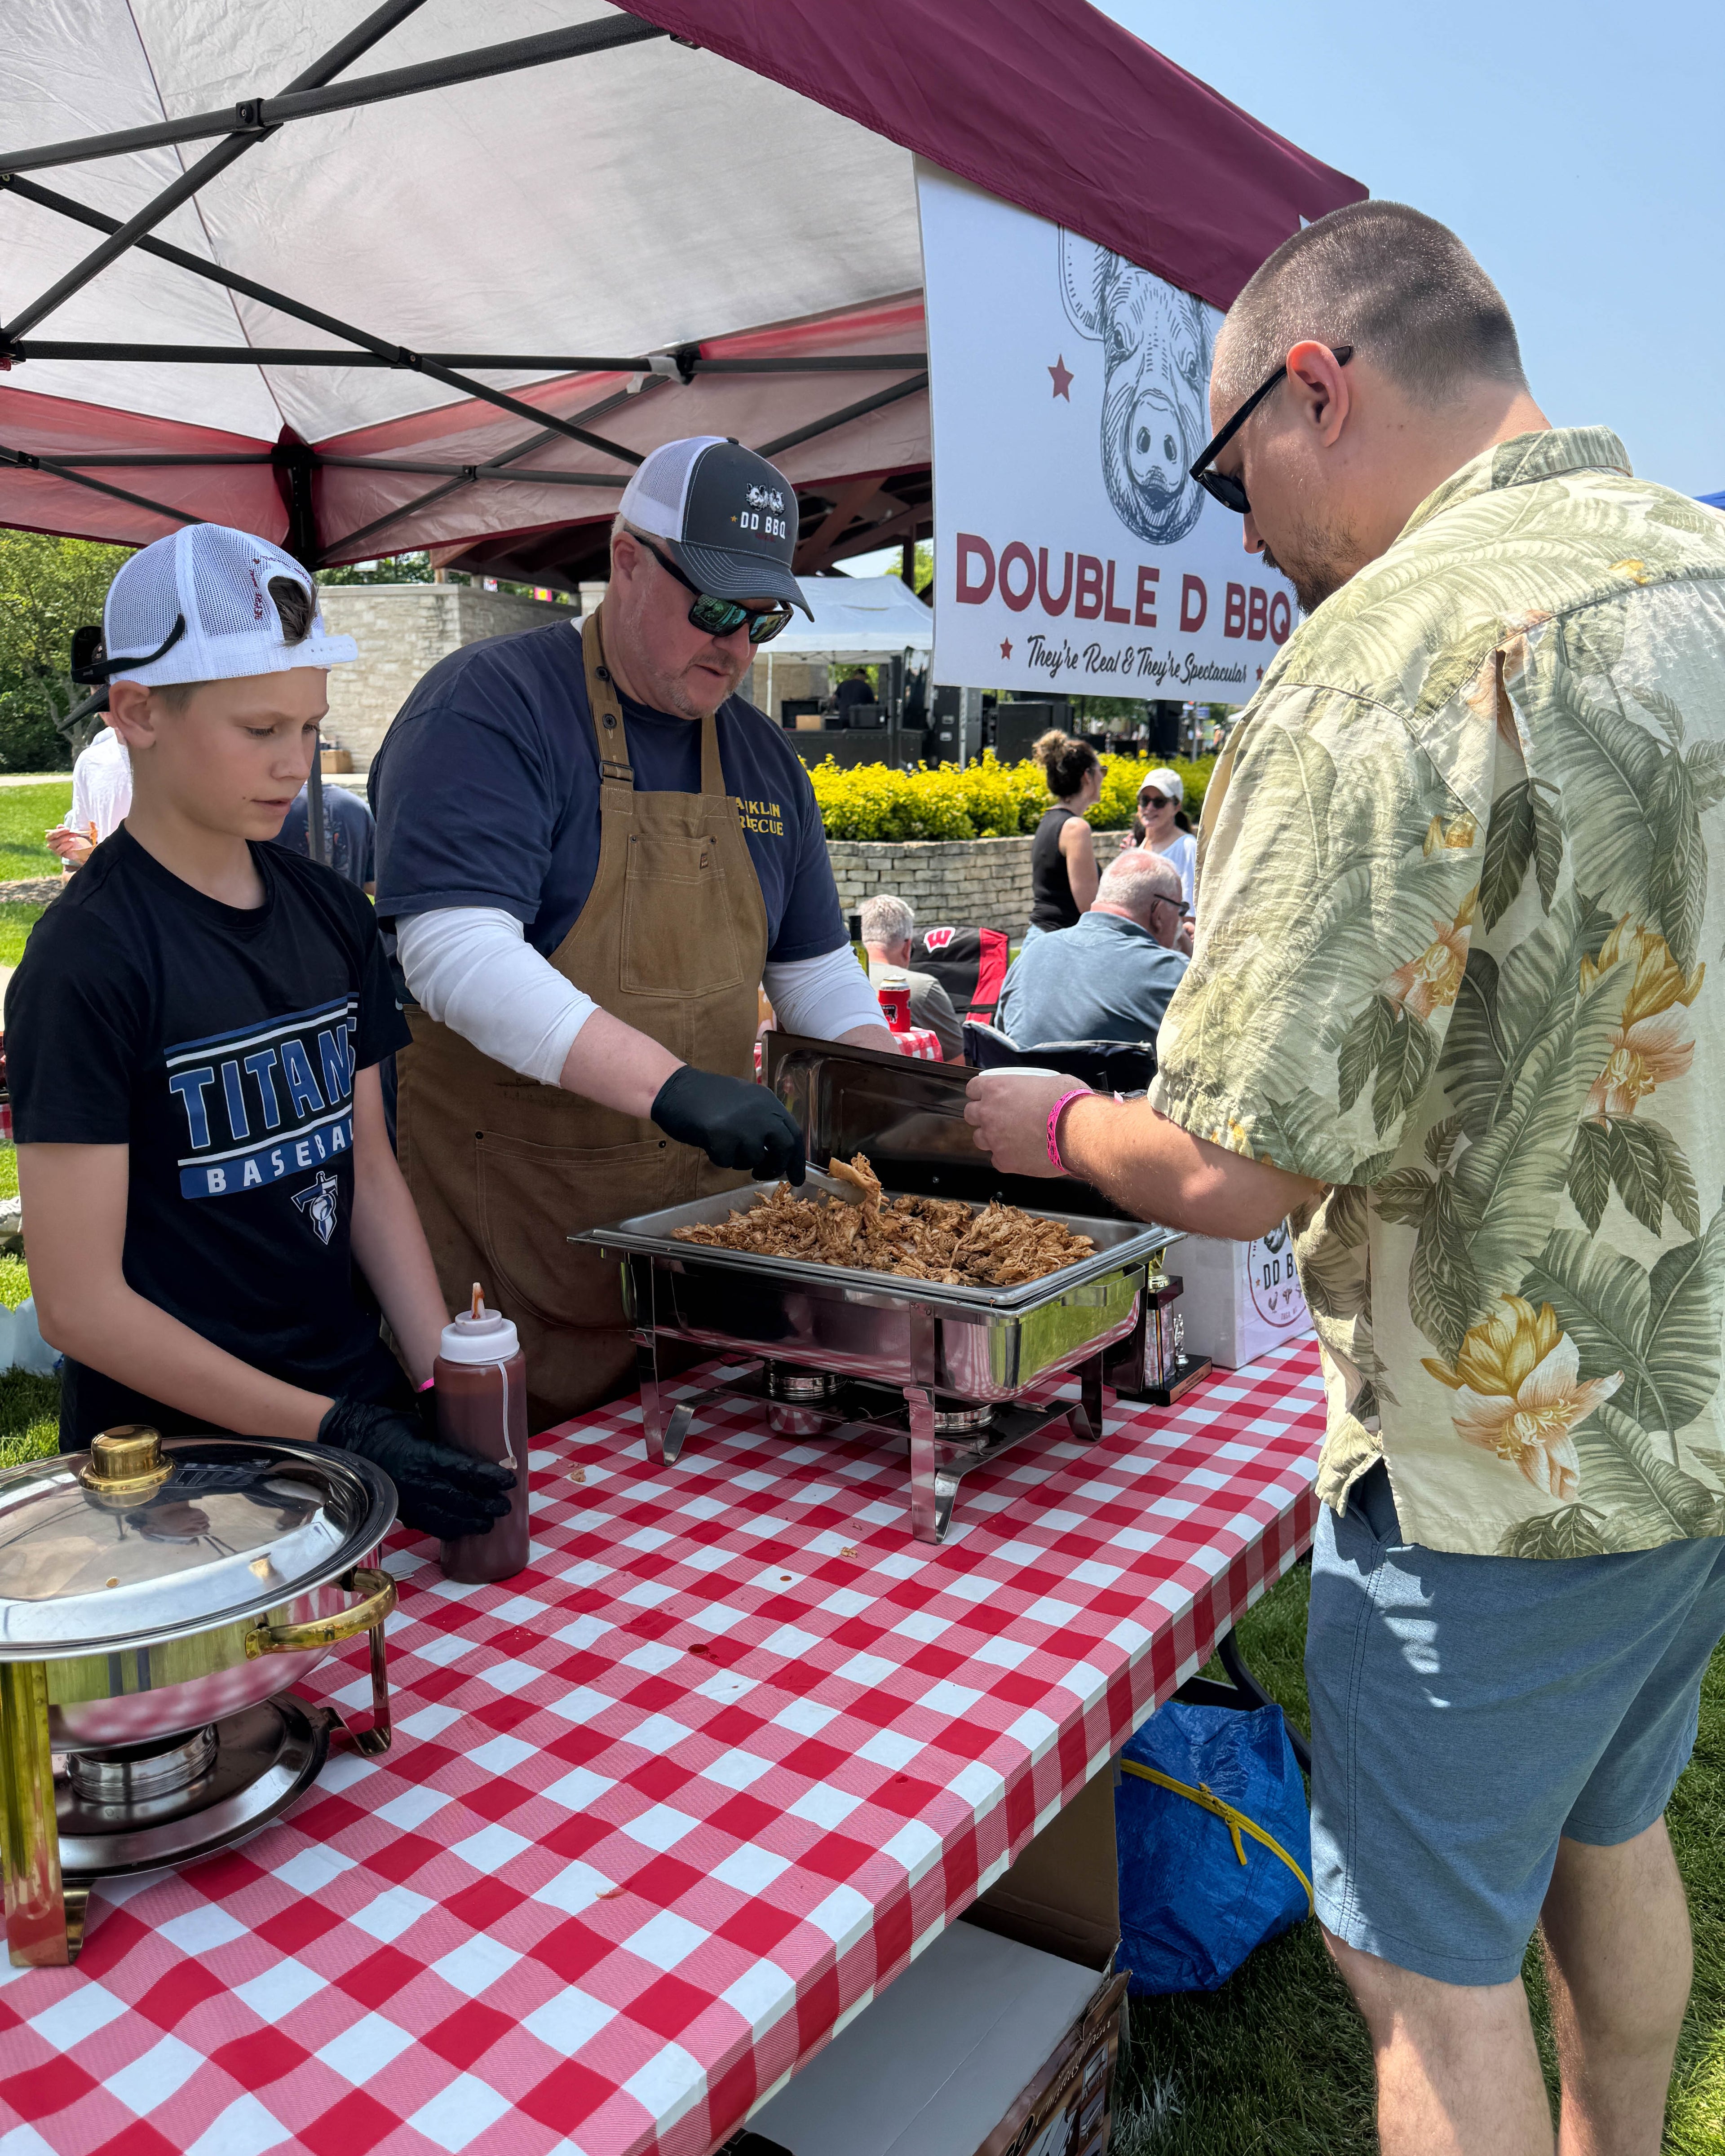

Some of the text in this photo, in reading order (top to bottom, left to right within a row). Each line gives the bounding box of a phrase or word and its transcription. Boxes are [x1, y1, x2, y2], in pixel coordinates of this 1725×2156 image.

[740, 511, 759, 530] DD
[765, 516, 786, 539] BBQ
[956, 532, 1291, 645] DOUBLE D BBQ
[1027, 635, 1247, 686] They're Real & They're Spectacular
[735, 797, 781, 817] AKLIN
[925, 928, 954, 951] W
[1263, 1259, 1279, 1290] DD
